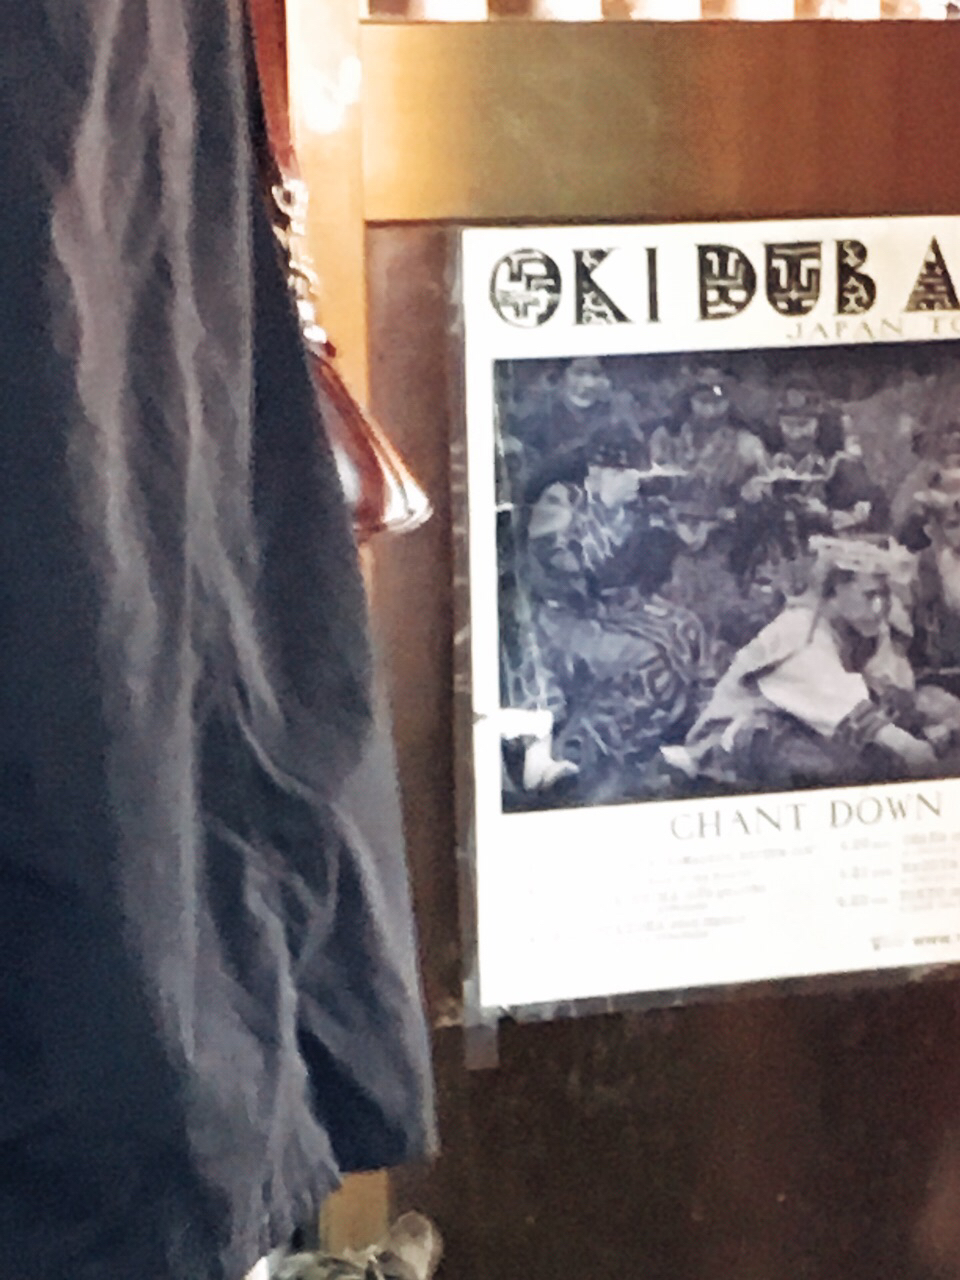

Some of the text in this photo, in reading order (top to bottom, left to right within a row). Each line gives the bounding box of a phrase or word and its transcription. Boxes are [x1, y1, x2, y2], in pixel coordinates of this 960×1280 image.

[488, 246, 661, 329] OKI
[695, 239, 877, 322] DUB
[786, 317, 903, 340] JAPAN
[671, 803, 807, 841] CHANT
[829, 791, 943, 829] DOWN
